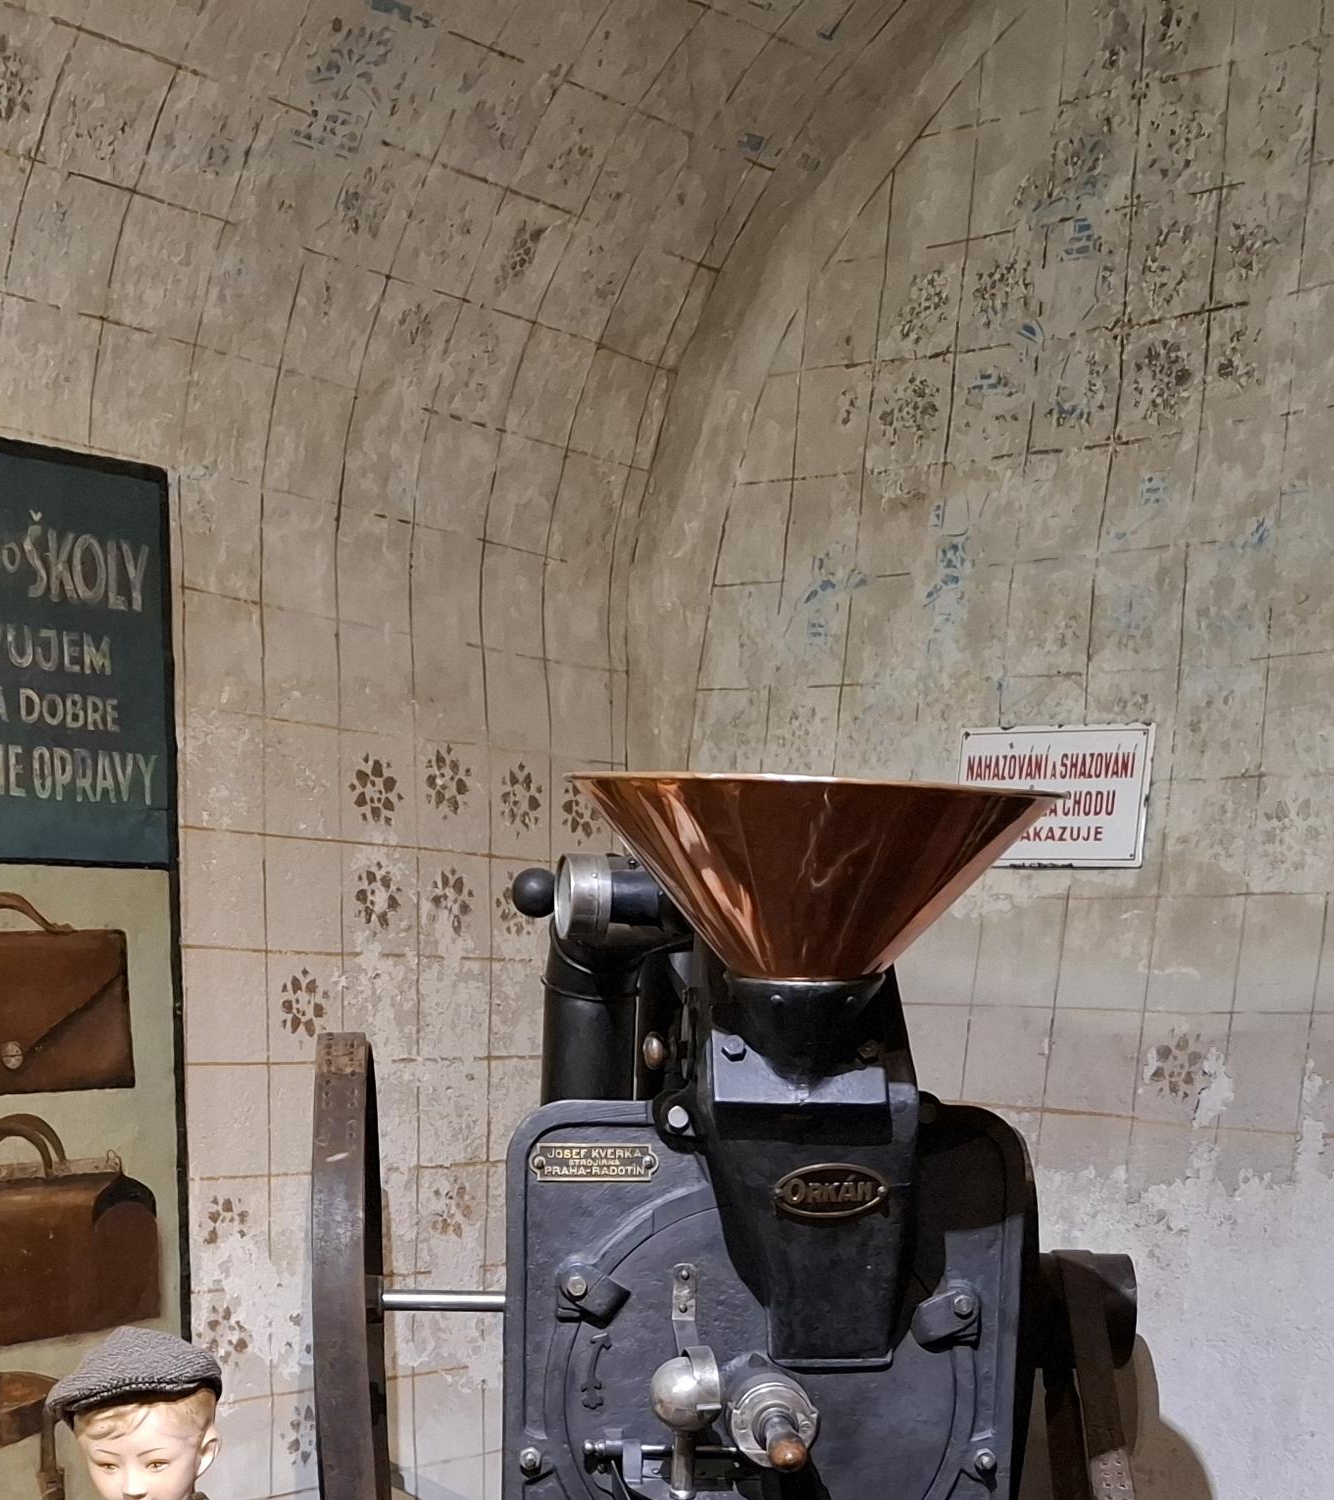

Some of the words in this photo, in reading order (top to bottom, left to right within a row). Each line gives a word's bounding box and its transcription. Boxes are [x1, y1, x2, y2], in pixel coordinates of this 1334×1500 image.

[23, 510, 149, 612] ŠKOLY
[19, 688, 120, 732] DOBRE
[32, 746, 157, 805] OPRAVY
[966, 745, 1051, 781] NAHAZOVÁNÍ
[1050, 761, 1057, 780] A
[1060, 743, 1138, 780] SHAZOVÁNÍ
[1062, 790, 1116, 817] CHODU
[1020, 826, 1104, 842] AKAZUJE
[547, 1148, 587, 1158] JOSEF
